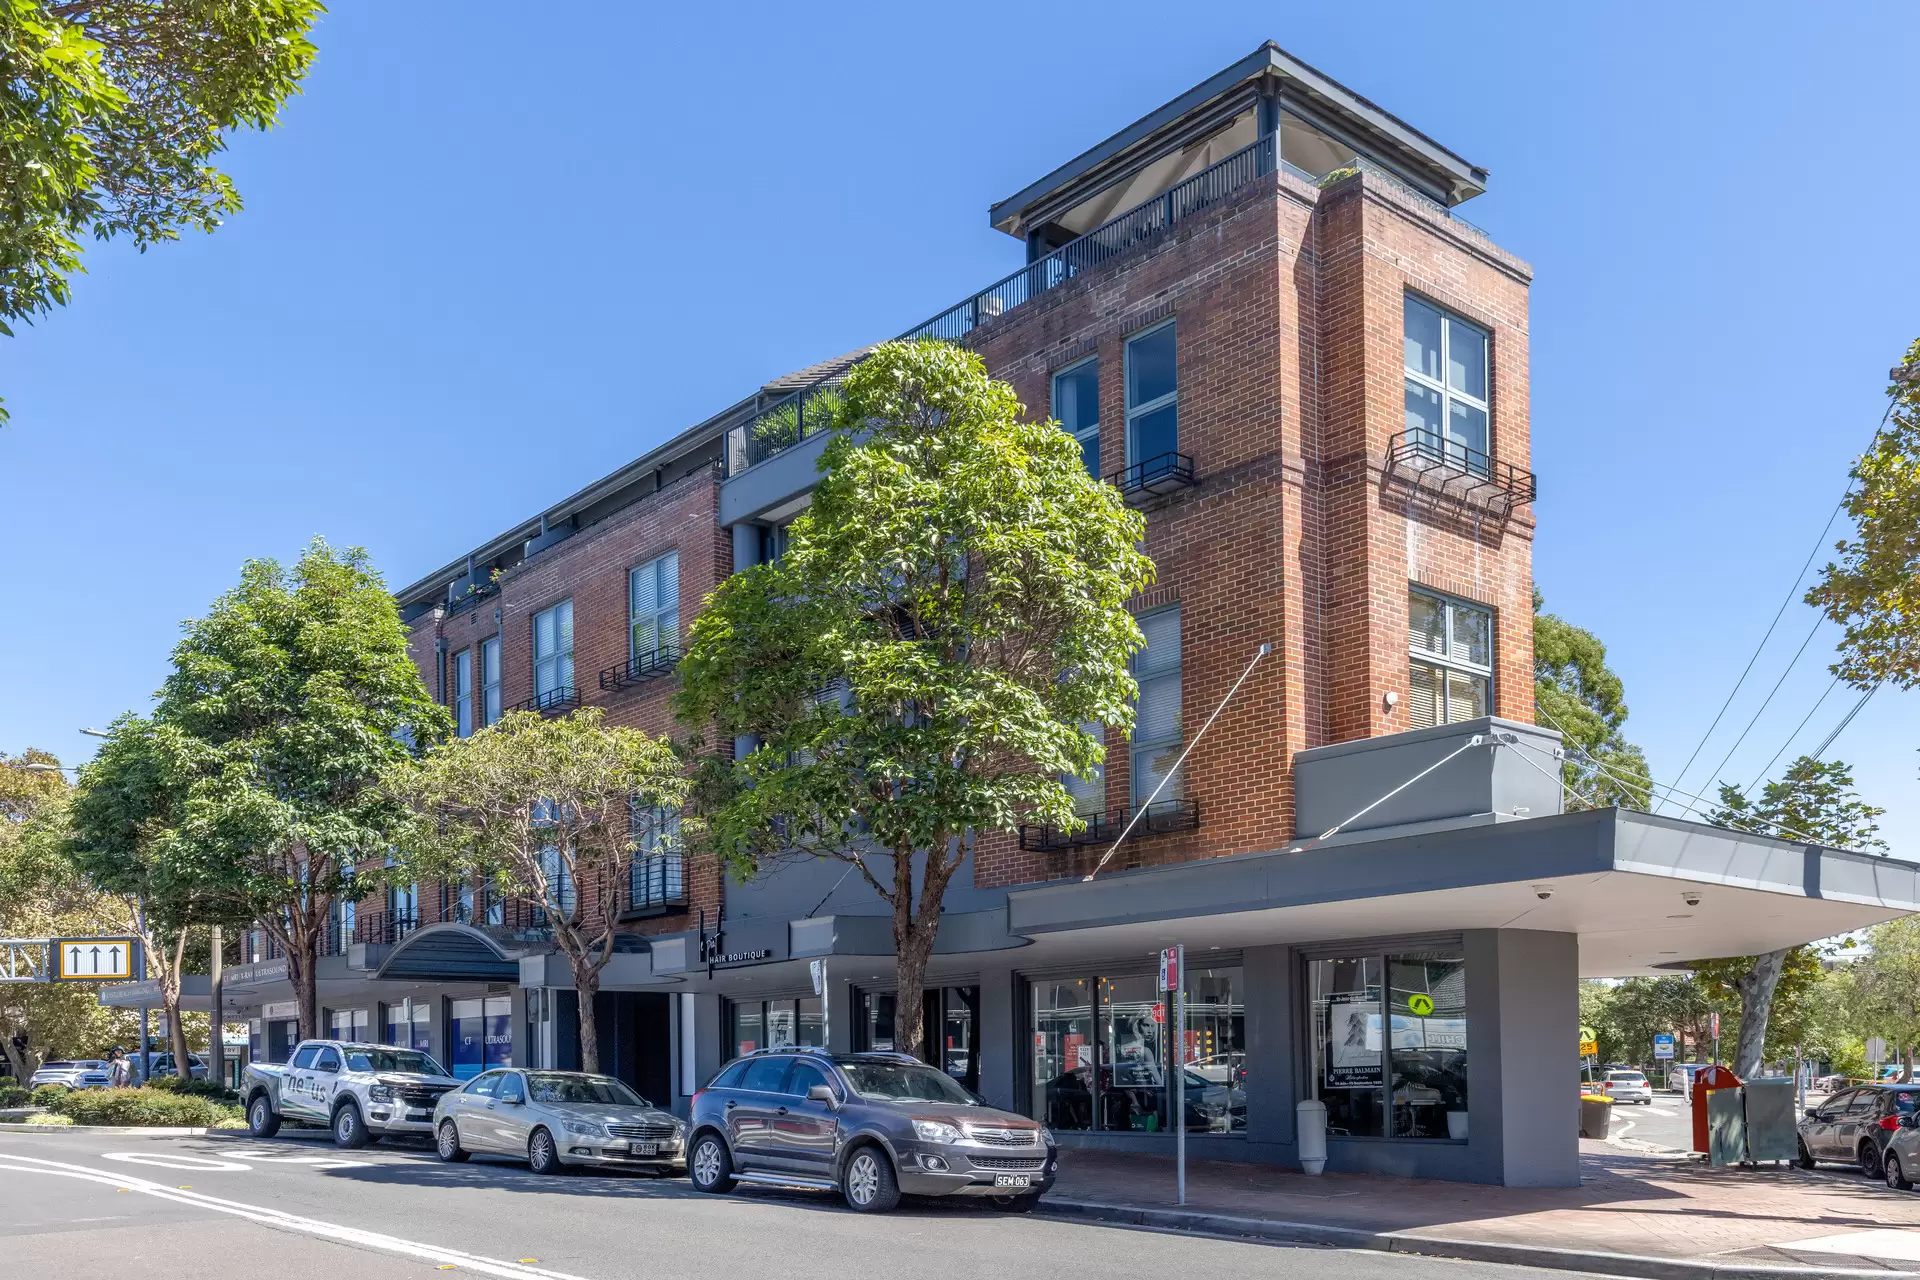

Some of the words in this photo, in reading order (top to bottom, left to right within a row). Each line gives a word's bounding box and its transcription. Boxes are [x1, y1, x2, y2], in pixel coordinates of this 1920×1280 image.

[709, 955, 727, 965] HAIR
[728, 949, 766, 962] BOUTIQUE
[255, 964, 287, 977] ULTRASOUND
[464, 1036, 472, 1046] CT
[997, 1176, 1014, 1186] SEM
[1015, 1176, 1029, 1186] 063
